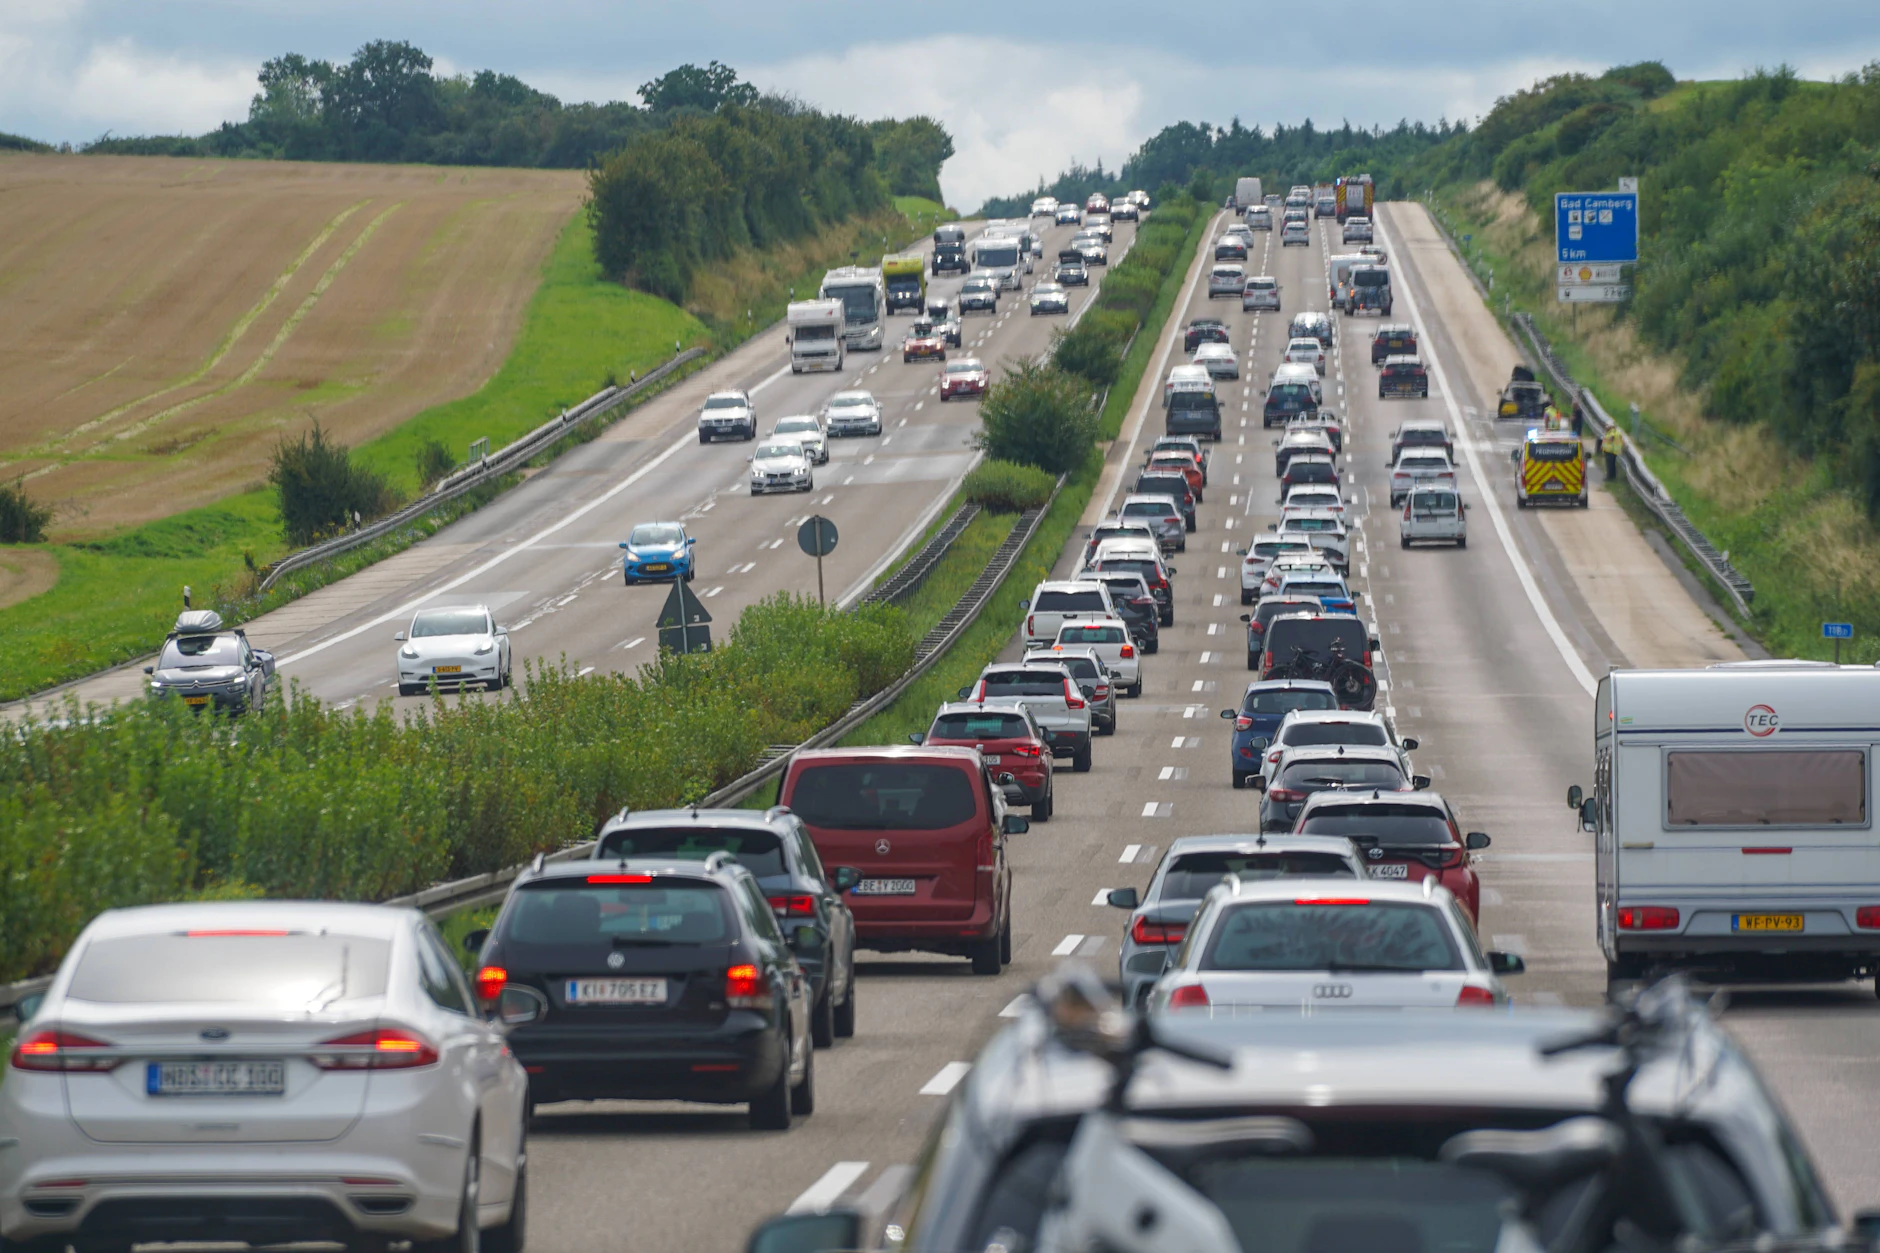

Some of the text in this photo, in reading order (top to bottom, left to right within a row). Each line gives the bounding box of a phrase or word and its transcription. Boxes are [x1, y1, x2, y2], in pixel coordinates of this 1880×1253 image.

[1560, 199, 1632, 211] Bad Camberg
[1570, 248, 1586, 258] km
[1749, 714, 1779, 726] TEC
[1381, 865, 1405, 878] 4047
[1746, 917, 1800, 929] WF-PV-93
